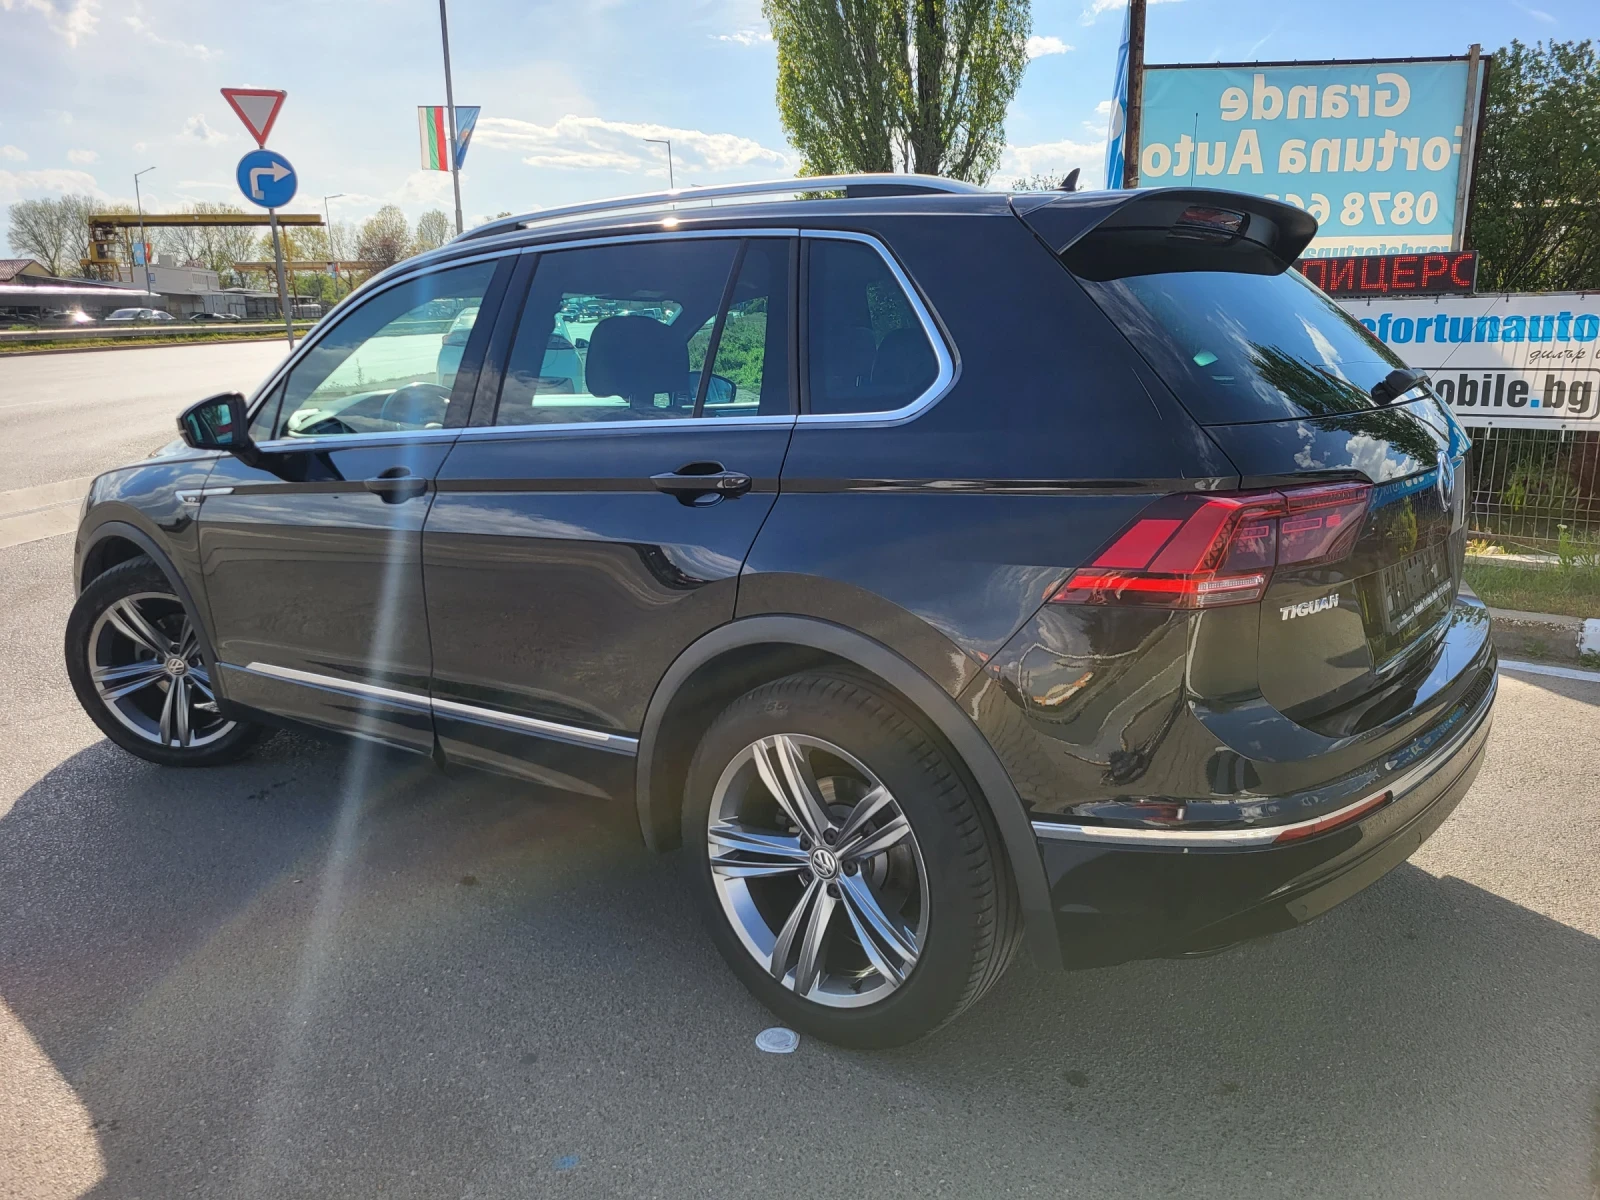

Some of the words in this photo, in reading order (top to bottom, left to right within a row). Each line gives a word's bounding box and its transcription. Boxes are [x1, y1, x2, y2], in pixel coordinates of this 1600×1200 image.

[1359, 311, 1600, 344] efortunauto
[1429, 373, 1593, 414] obile.bg
[1279, 593, 1340, 621] TIGUAN
